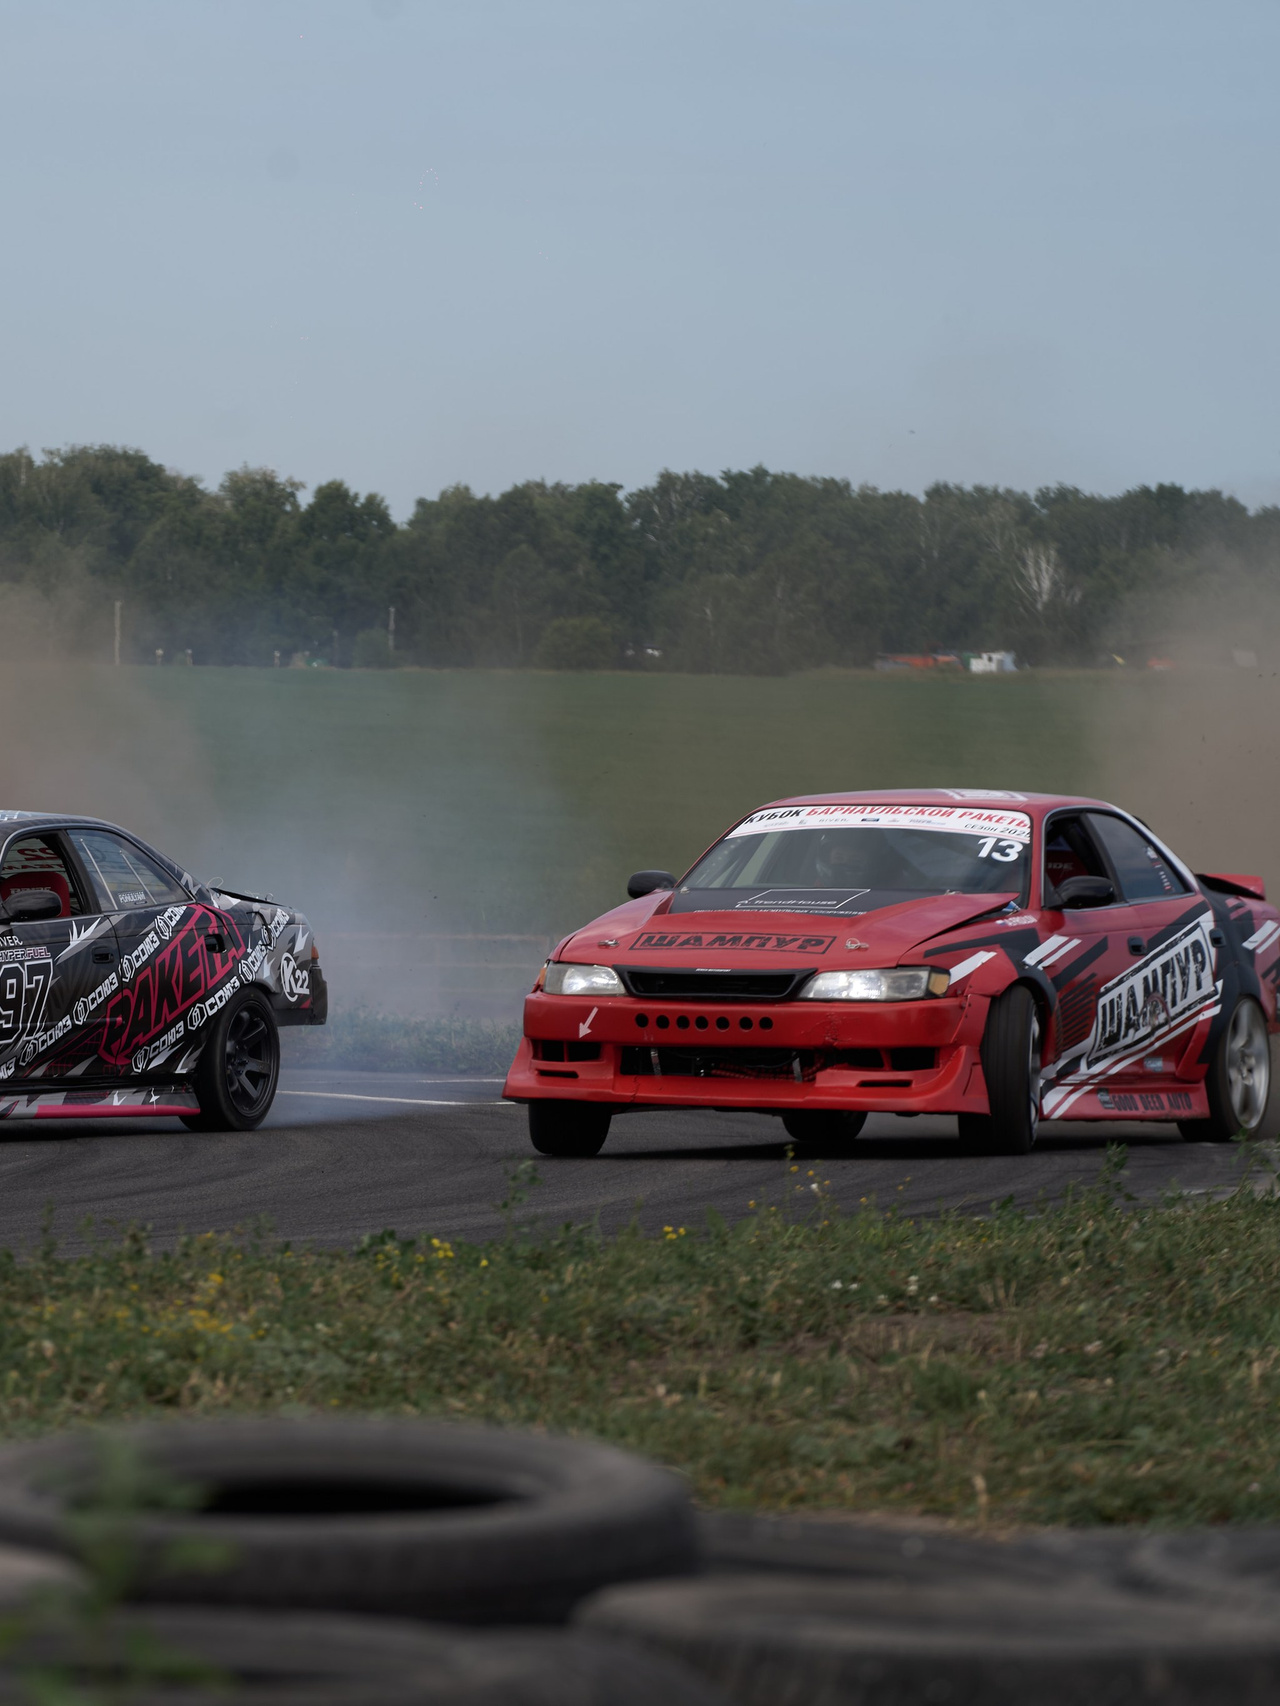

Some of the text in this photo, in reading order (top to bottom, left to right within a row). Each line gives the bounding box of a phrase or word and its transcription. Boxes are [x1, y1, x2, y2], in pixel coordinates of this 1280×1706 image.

[744, 809, 805, 824] КУБОК
[806, 806, 957, 818] БАРНАУЛЬСКОЙ
[964, 823, 998, 832] СЕЗОН
[977, 837, 1024, 862] 13
[134, 931, 160, 969] СОЮЗ
[640, 935, 826, 951] ШАМПУР
[88, 972, 119, 1012] СОЮЗ
[1096, 938, 1207, 1053] ШАМПУР
[38, 1014, 73, 1053] СОЮЗ
[150, 1020, 185, 1058] СОЮЗ
[1112, 1094, 1139, 1111] GOOD
[1139, 1094, 1166, 1111] DEED
[1166, 1092, 1193, 1110] AUTO
